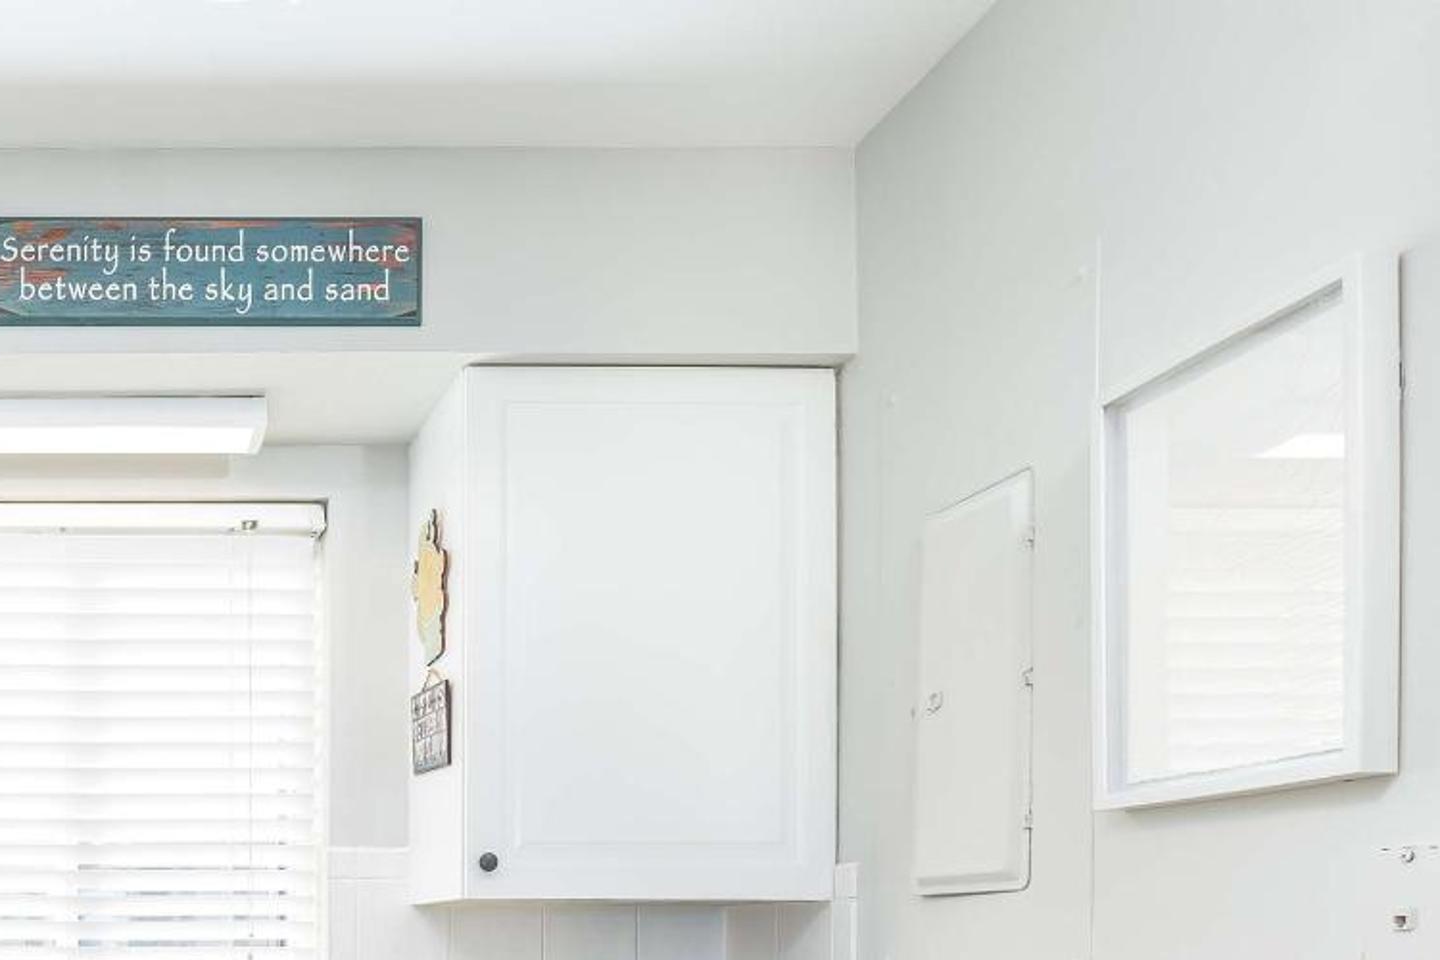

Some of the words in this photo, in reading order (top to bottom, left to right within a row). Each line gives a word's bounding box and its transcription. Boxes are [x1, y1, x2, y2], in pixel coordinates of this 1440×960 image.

[0, 235, 120, 275] Serenity
[130, 235, 153, 263] is
[163, 228, 245, 262] found
[256, 230, 411, 263] somewhere
[19, 269, 138, 303] between
[148, 267, 194, 301] the
[205, 267, 253, 315] sky
[264, 268, 313, 301] and
[325, 269, 391, 301] sand
